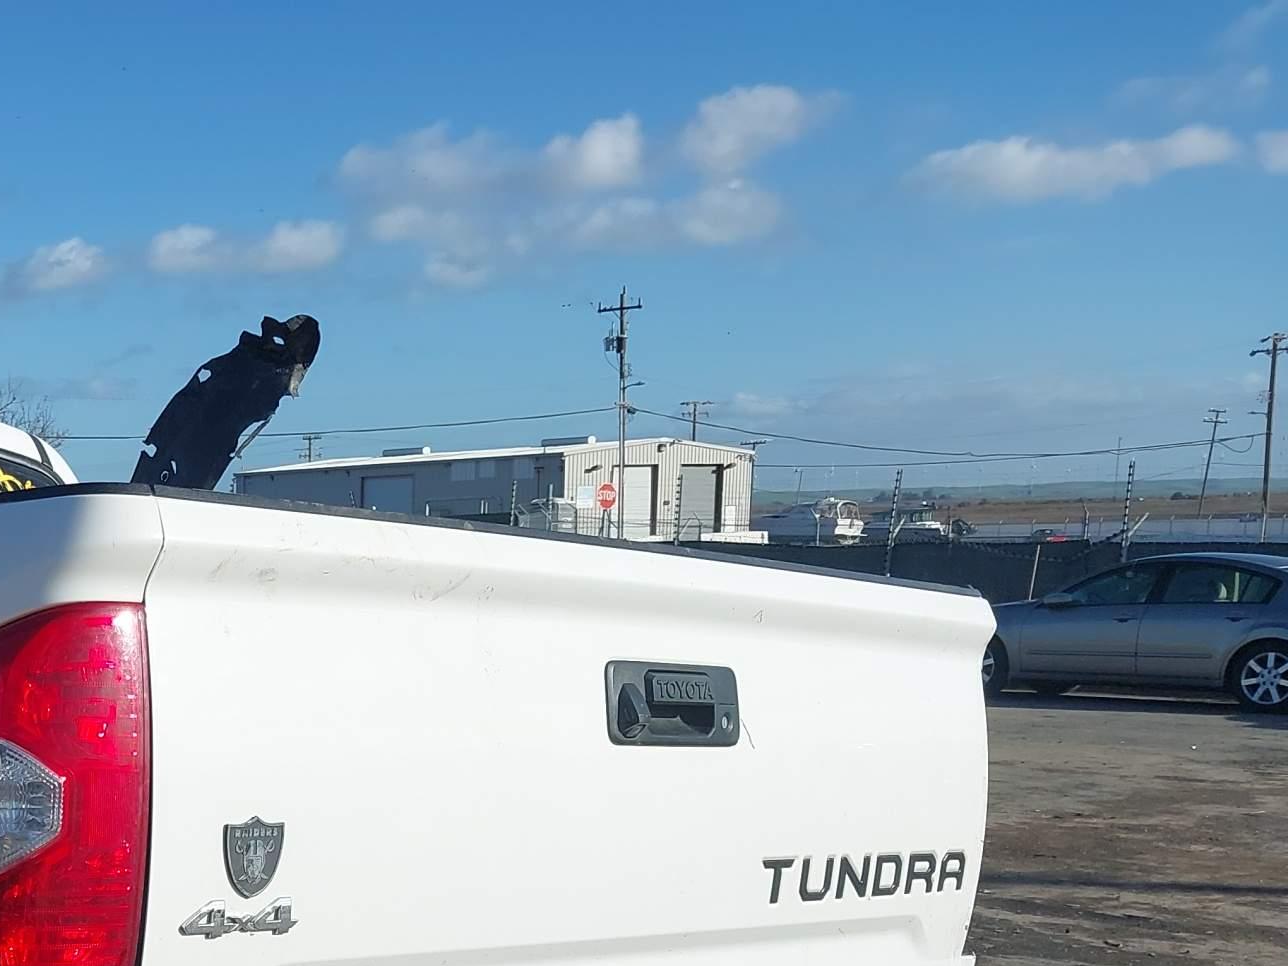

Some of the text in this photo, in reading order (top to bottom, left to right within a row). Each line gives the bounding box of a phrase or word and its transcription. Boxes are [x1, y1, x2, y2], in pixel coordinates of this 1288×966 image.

[598, 490, 616, 501] STOP
[656, 679, 714, 700] TOYOTA
[234, 827, 279, 838] RAIDERS
[761, 849, 966, 905] TUNDRA
[178, 896, 299, 940] 4x4
